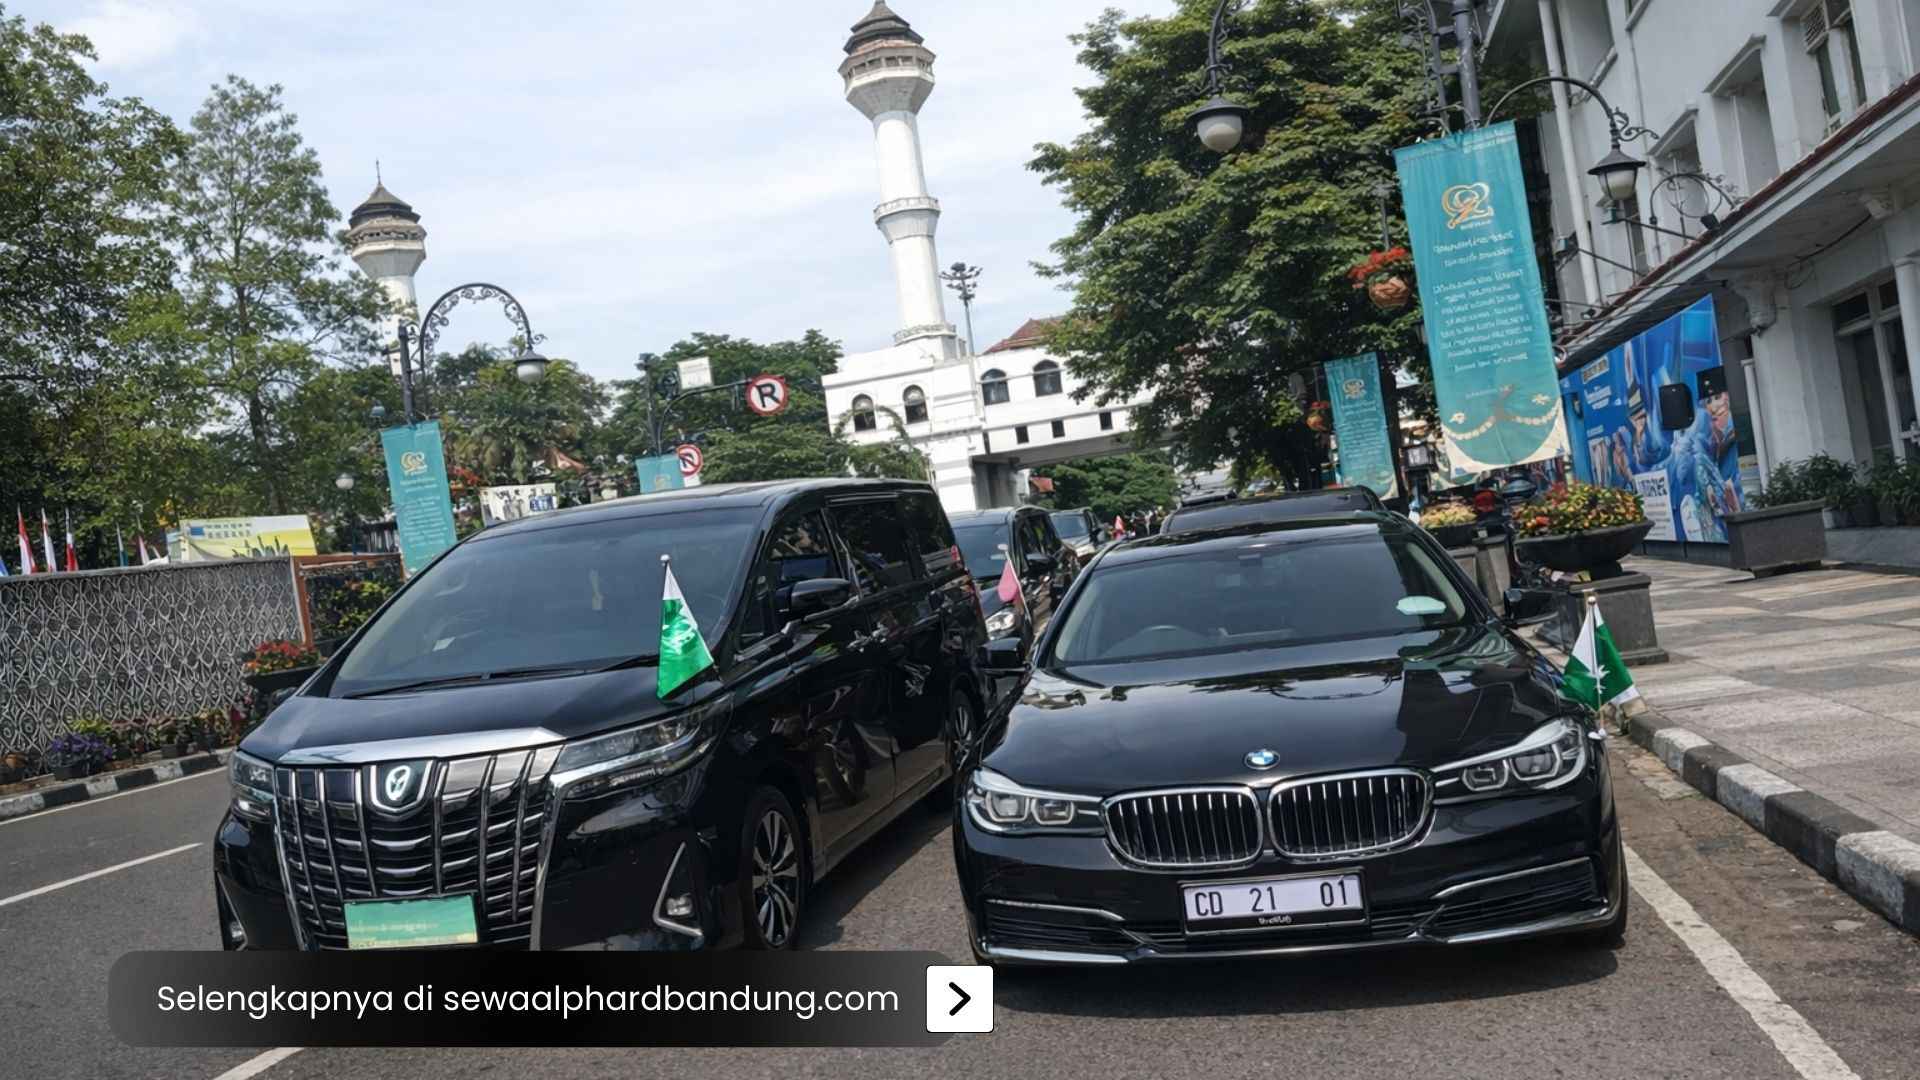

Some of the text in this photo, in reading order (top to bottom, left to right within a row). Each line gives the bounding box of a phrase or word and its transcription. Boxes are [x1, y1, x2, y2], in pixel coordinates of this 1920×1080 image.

[1194, 879, 1348, 917] CD 21 01
